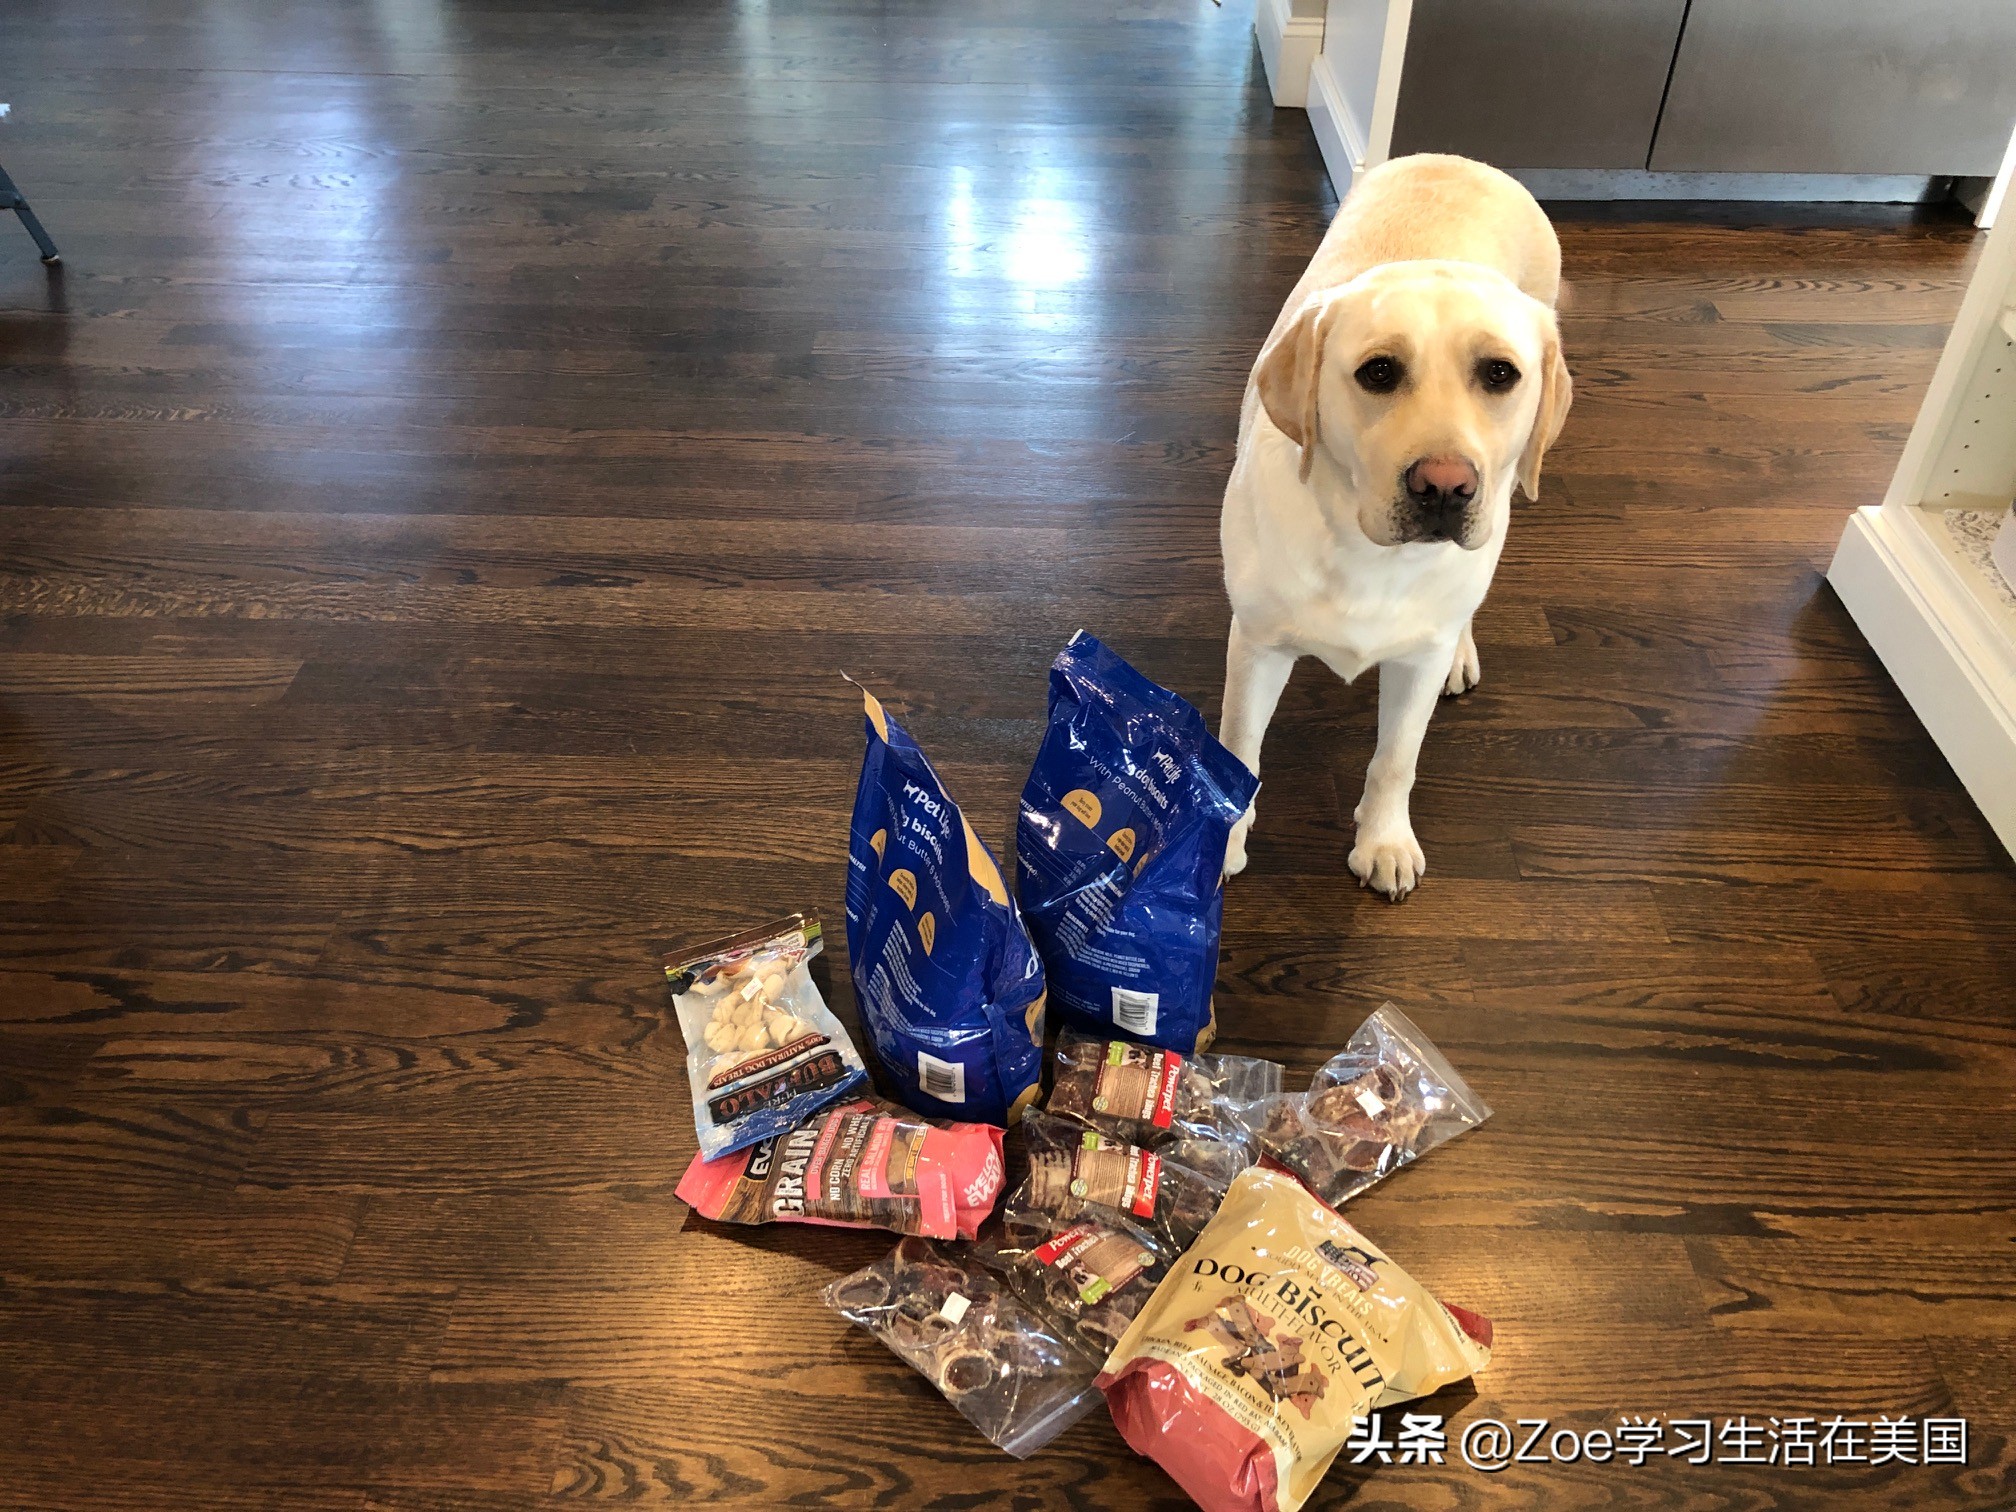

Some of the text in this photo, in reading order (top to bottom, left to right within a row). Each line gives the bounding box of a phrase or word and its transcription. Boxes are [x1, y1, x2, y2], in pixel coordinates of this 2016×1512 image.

[1089, 756, 1112, 779] With
[1112, 776, 1142, 805] Peanut
[746, 1060, 766, 1070] DOG
[768, 1043, 806, 1064] NATURAL
[713, 1069, 744, 1086] TREATS
[720, 1055, 837, 1116] BUFFALO
[841, 1137, 854, 1149] NO
[865, 1132, 883, 1165] SALMON
[829, 1158, 845, 1201] NO CORN
[842, 1158, 855, 1177] ZERO
[860, 1168, 873, 1190] REAL
[1193, 1258, 1271, 1287] DOG
[1283, 1245, 1321, 1271] DOG
[1320, 1265, 1374, 1315] TREATS
[1188, 1361, 1223, 1391] PACKAGED
[1224, 1389, 1233, 1399] IN
[1233, 1397, 1248, 1413] RED
[1230, 1378, 1256, 1404] BACON
[1256, 1400, 1263, 1409] &
[1222, 1400, 1235, 1413] OZ
